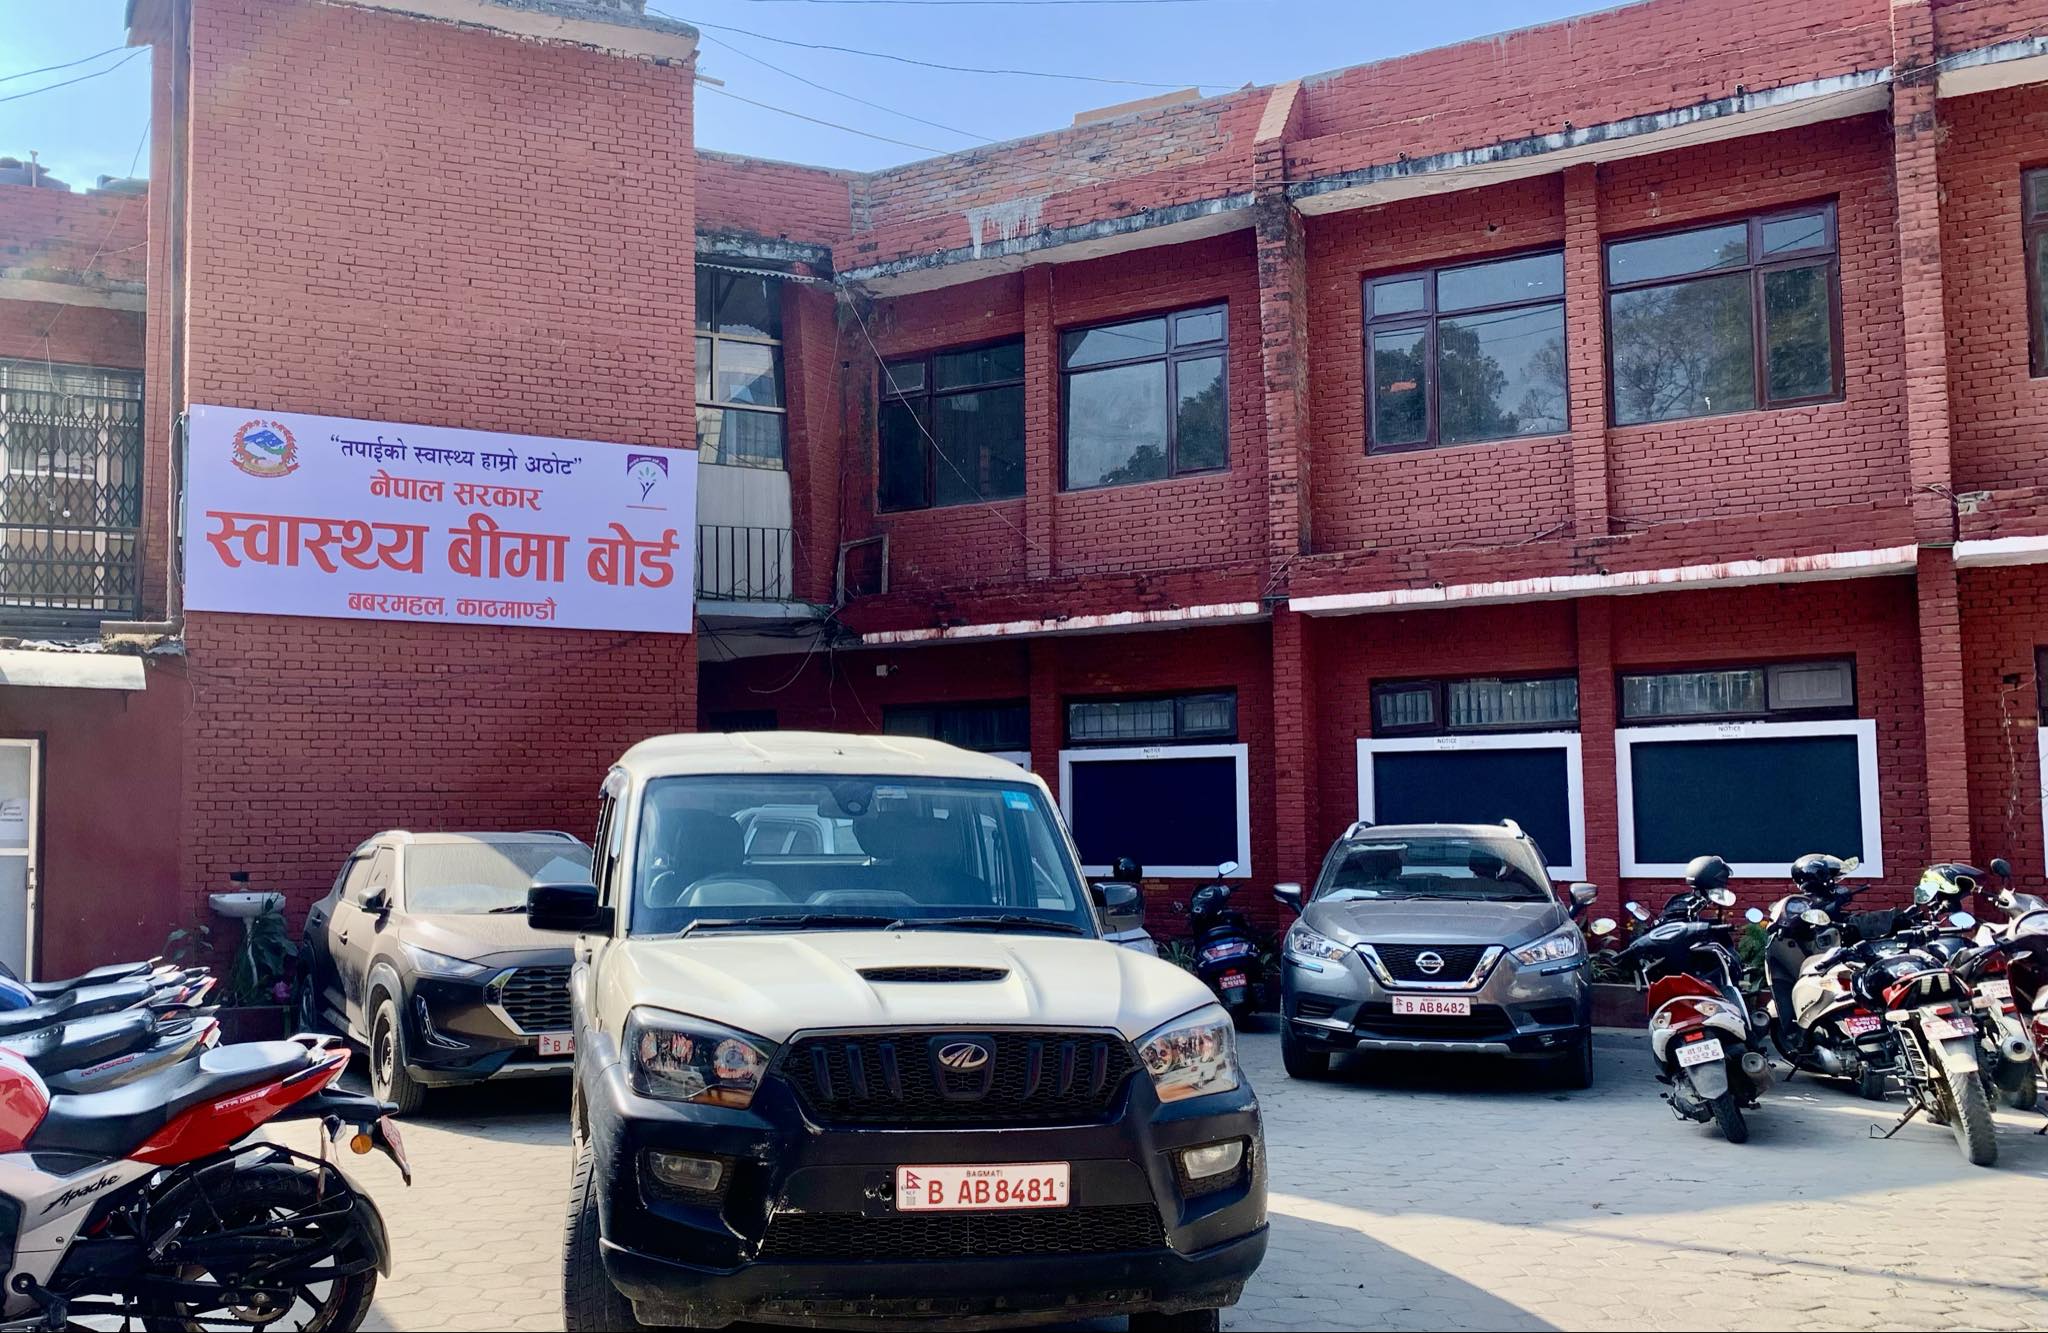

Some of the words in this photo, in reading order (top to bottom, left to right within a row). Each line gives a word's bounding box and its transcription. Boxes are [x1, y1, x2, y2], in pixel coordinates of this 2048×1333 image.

[413, 446, 475, 467] स्वास्थ्य
[480, 448, 519, 472] हाम्रो
[525, 451, 582, 475] अठोट”
[369, 469, 445, 503] नेपाल
[453, 482, 544, 511] सरकार
[205, 510, 430, 574] स्वास्थ्य
[447, 512, 571, 582] बीमा
[586, 522, 680, 589] बोर्ड
[1406, 1001, 1413, 1012] B
[553, 1040, 560, 1051] B
[966, 1170, 1004, 1178] BAGMATI
[39, 1174, 122, 1216] Apache
[928, 1180, 944, 1205] B
